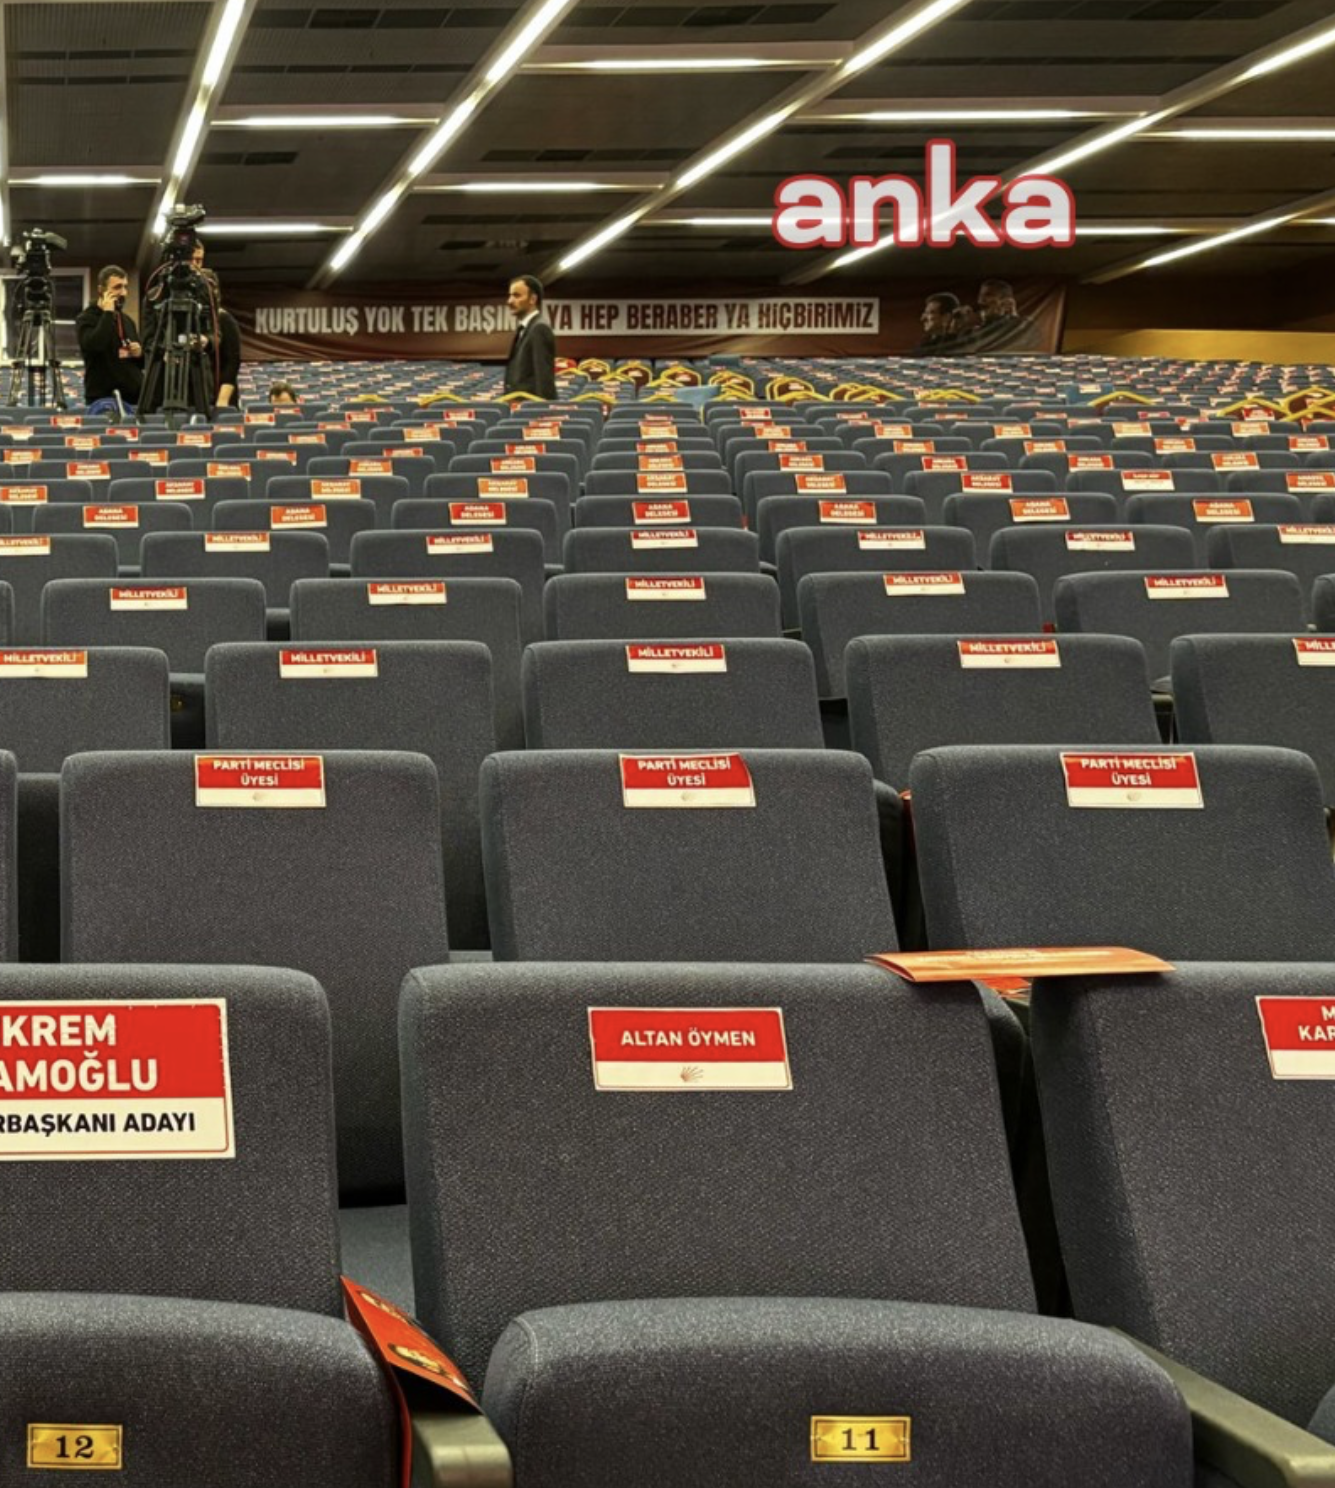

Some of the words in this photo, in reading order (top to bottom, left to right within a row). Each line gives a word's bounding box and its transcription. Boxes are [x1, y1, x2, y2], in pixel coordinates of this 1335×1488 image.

[255, 306, 359, 336] KURTULUŞ
[365, 306, 405, 333] YOK
[411, 306, 449, 333] TEK
[455, 305, 517, 335] BAŞIN
[546, 304, 573, 331] YA
[580, 304, 619, 330] HEP
[626, 304, 717, 330] BERABER
[724, 303, 750, 329] YA
[638, 646, 714, 657] MİLLETVEKİLİ
[969, 641, 1046, 652] MİLLETVEKİLİ
[3, 651, 76, 663] MİLLETVEKİLİ
[291, 651, 365, 662] MİLLETVEKİLİ
[213, 758, 255, 771] PARTİ
[257, 758, 304, 771] MECLİSİ
[637, 758, 677, 770] PARTİ
[679, 758, 731, 770] MECLİSİ
[1081, 757, 1122, 769] PARTİ
[1123, 757, 1176, 770] MECLİSİ
[241, 773, 278, 786] ÜYESİ
[667, 772, 706, 785] ÜYESİ
[1112, 772, 1152, 785] ÜYESİ
[621, 1030, 683, 1046] ALTAN
[688, 1027, 756, 1046] ÖYMEN
[123, 1112, 195, 1131] ADAYI
[841, 1428, 880, 1451] 11
[56, 1434, 94, 1459] 12
